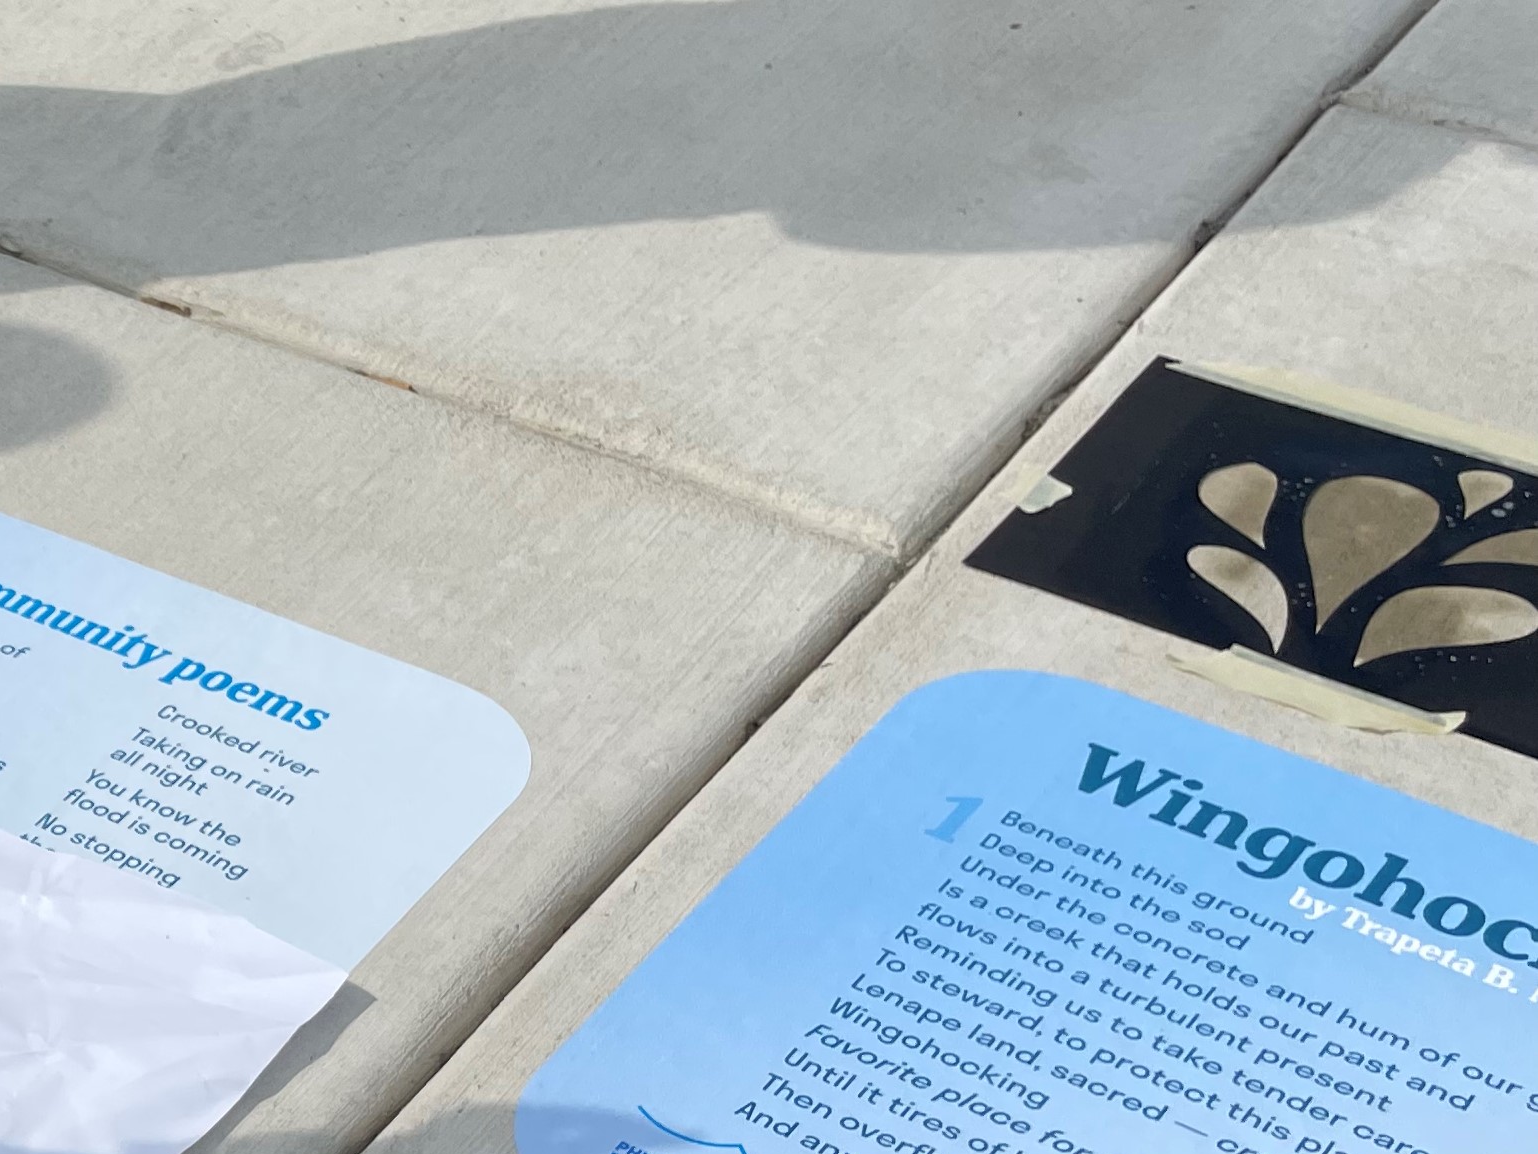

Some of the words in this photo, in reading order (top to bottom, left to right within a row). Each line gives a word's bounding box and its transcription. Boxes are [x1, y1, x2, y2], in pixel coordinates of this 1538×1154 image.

[0, 644, 31, 659] of
[157, 656, 331, 732] poems
[109, 749, 145, 768] all
[141, 761, 209, 797] night
[131, 726, 208, 772] Taking
[210, 764, 243, 785] on
[244, 778, 296, 806] rain
[157, 704, 261, 755] Crooked
[258, 749, 320, 778] river
[85, 768, 128, 798] You
[127, 788, 198, 827] know
[198, 820, 242, 847] the
[924, 796, 984, 844] 1
[34, 812, 68, 836] No
[69, 832, 182, 889] stopping
[1000, 810, 1122, 871] Beneath
[1130, 863, 1188, 895] this
[1191, 891, 1315, 945] ground
[1077, 742, 1538, 962] Wingohoc
[979, 832, 1055, 874] Deep
[1061, 864, 1122, 900] into
[1129, 893, 1181, 924] the
[1187, 920, 1251, 951] sod
[959, 855, 1052, 901] Under
[1055, 895, 1107, 926] the
[1113, 922, 1259, 988] concrete
[1265, 984, 1333, 1018] and
[1335, 1007, 1410, 1051] hum
[1418, 1047, 1461, 1068] of
[1462, 1065, 1524, 1095] our
[1289, 886, 1337, 920] by
[1341, 906, 1476, 977] Trapeta
[1482, 963, 1518, 994] B.
[894, 924, 1059, 1008] Reminding
[1064, 999, 1103, 1024] us
[1110, 1016, 1143, 1041] to
[1151, 1034, 1223, 1075] take
[1231, 1068, 1349, 1127] tender
[917, 902, 998, 945] flows
[1002, 936, 1065, 974] into
[1069, 970, 1091, 986] a
[1098, 978, 1254, 1054] turbulent
[1252, 1048, 1393, 1113] present
[937, 878, 965, 899] Is
[969, 895, 989, 910] a
[995, 906, 1086, 950] creek
[1090, 941, 1158, 980] that
[1161, 969, 1252, 1019] holds
[1258, 1015, 1318, 1044] our
[1318, 1040, 1401, 1082] past
[1405, 1076, 1477, 1112] and
[829, 996, 1051, 1111] Wingohocking
[733, 1100, 800, 1139] And
[762, 1072, 833, 1120] Then
